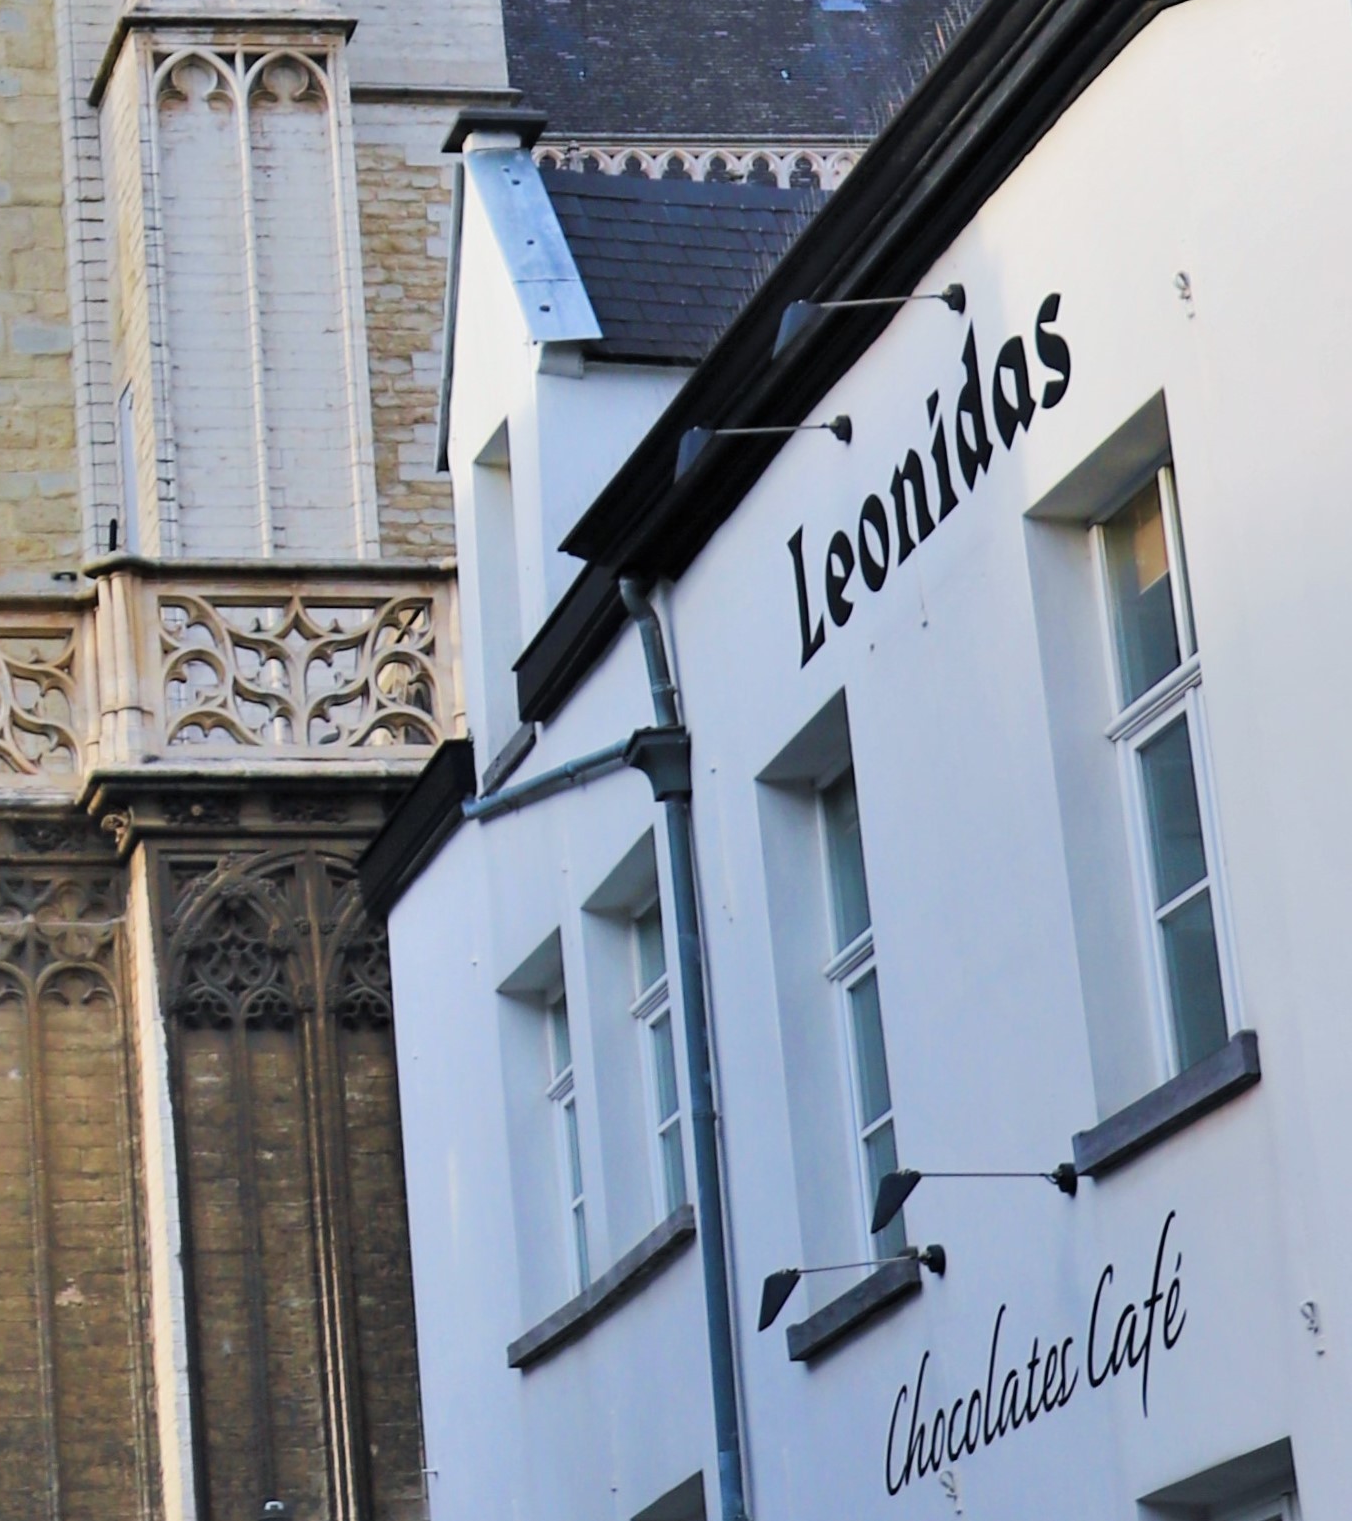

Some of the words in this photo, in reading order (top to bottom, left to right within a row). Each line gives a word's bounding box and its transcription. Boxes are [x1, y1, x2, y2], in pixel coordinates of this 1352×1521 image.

[787, 292, 1072, 669] Leonidas
[885, 1303, 1078, 1497] Chocolates
[1087, 1210, 1187, 1418] Café
